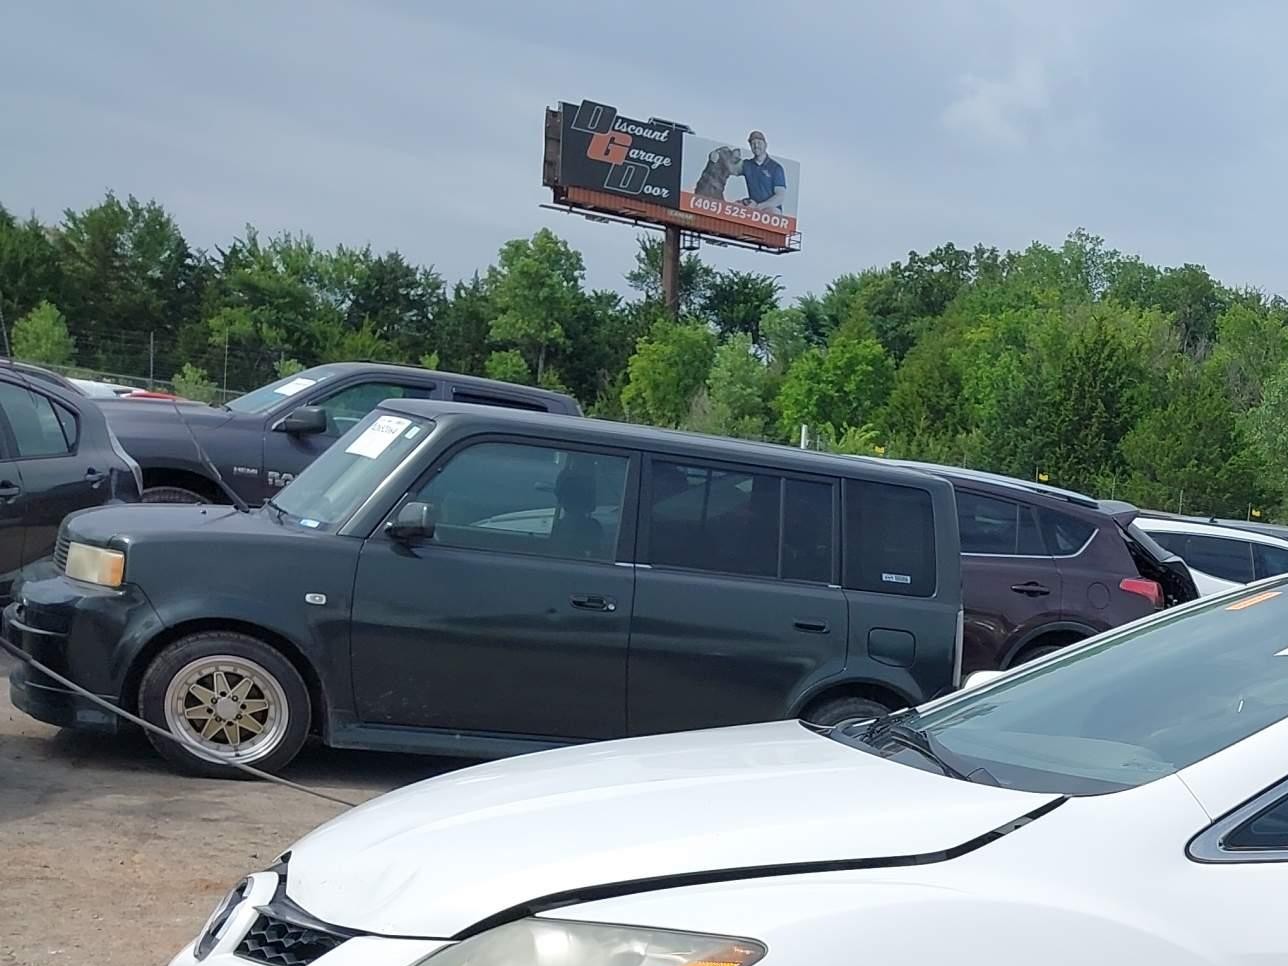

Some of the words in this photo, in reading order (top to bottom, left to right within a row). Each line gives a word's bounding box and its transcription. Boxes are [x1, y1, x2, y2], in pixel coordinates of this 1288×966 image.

[571, 99, 669, 143] Discount
[586, 131, 672, 167] Garage
[604, 161, 669, 199] Door
[690, 196, 723, 215] (405)
[725, 205, 789, 230] 525-DOOR
